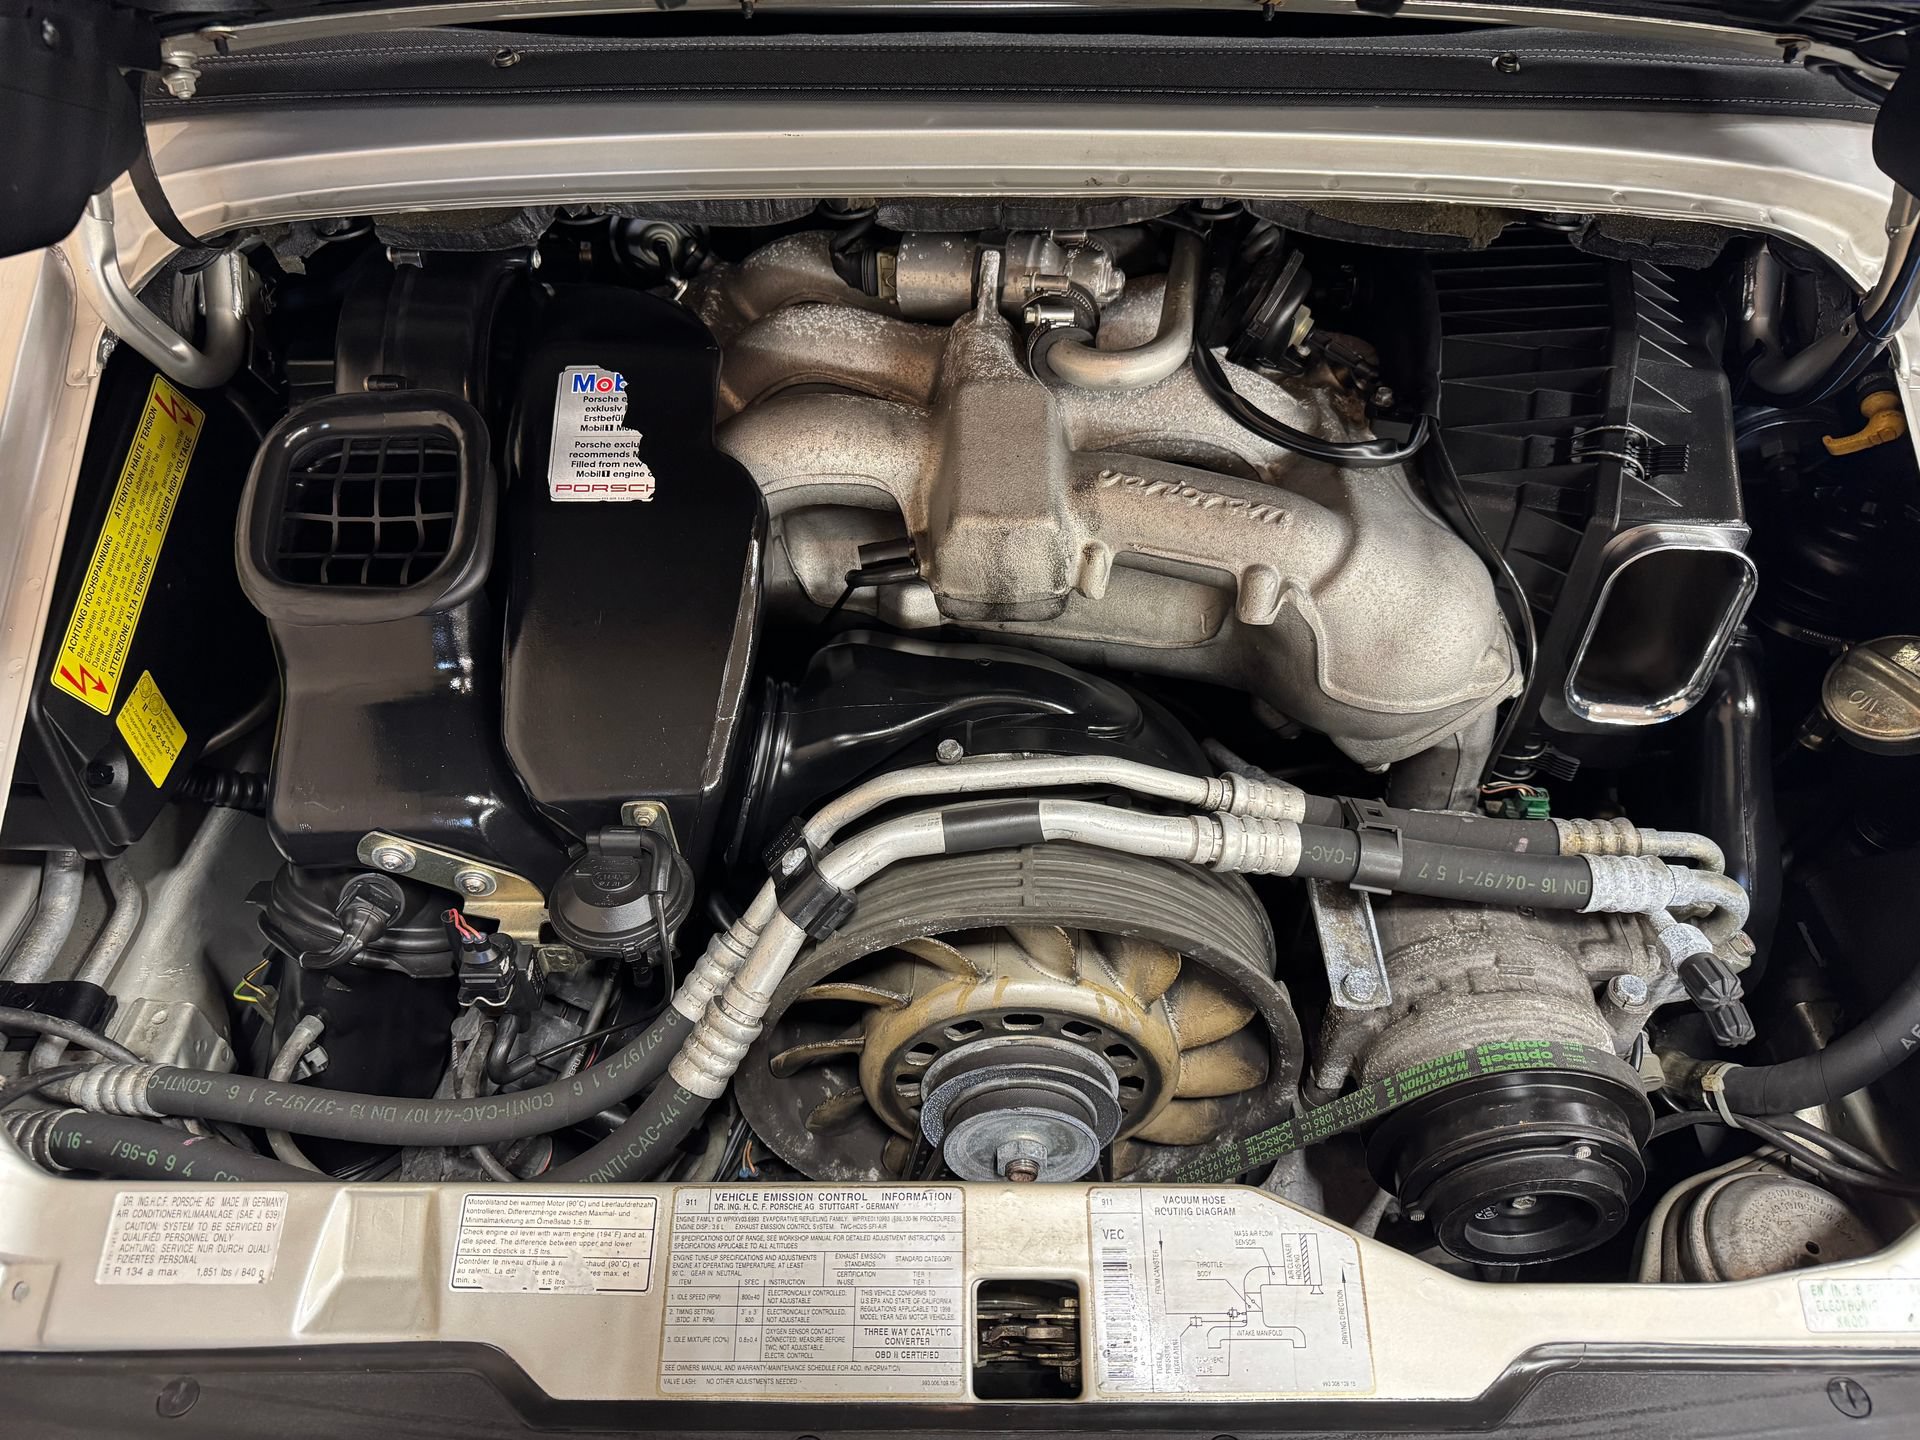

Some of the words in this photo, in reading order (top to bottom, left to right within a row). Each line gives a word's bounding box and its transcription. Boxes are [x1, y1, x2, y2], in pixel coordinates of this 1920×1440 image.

[116, 470, 135, 519] ATTENTION
[132, 441, 145, 471] HAUTE
[142, 406, 157, 441] TENSION
[613, 471, 645, 479] engine
[157, 496, 172, 532] DANGER
[169, 473, 179, 496] HIGH
[177, 435, 193, 473] VOLTAGE
[69, 608, 88, 653] ACHTUNG
[85, 535, 113, 607] HOCHSPANNUNG
[110, 623, 130, 678] ATTENZIONE
[127, 599, 138, 622] ALTA
[135, 555, 152, 596] TENSIONE
[1563, 879, 1588, 895] DN
[1480, 1051, 1553, 1067] optibelt
[1400, 1061, 1469, 1097] MARATHON
[1247, 1130, 1294, 1157] PORSCHE
[67, 1132, 82, 1149] 16
[164, 1155, 177, 1172] 9
[182, 1161, 196, 1178] 4
[172, 1196, 203, 1207] PORSCHE
[205, 1196, 215, 1207] AG
[221, 1196, 240, 1207] MADE
[242, 1196, 249, 1207] IN
[252, 1196, 284, 1207] GERMANY
[715, 1193, 758, 1201] VEHICLE
[763, 1193, 813, 1201] EMISSION
[818, 1193, 868, 1201] CONTROL
[881, 1193, 952, 1201] INFORMATION
[1102, 1198, 1113, 1206] 911
[1163, 1196, 1199, 1204] VACUUM
[1202, 1196, 1226, 1204] HOSE
[714, 1203, 726, 1211] DR.
[727, 1203, 741, 1211] ING.
[770, 1203, 803, 1211] PORSCHE
[805, 1203, 814, 1211] AG
[819, 1203, 859, 1211] STUTTGART
[866, 1203, 900, 1211] GERMANY
[1154, 1207, 1193, 1216] ROUTING
[1196, 1207, 1236, 1216] DIAGRAM
[116, 1209, 129, 1218] AIR
[163, 1222, 194, 1231] SYSTEM
[198, 1222, 208, 1231] TO
[212, 1222, 222, 1231] BE
[225, 1222, 263, 1231] SERVICED
[266, 1222, 277, 1231] BY
[122, 1233, 160, 1242] QUALIFIED
[165, 1233, 209, 1242] PERSONNEL
[213, 1233, 234, 1242] ONLY
[1102, 1229, 1125, 1240] VEC
[161, 1243, 194, 1253] SERVICE
[197, 1243, 214, 1253] NUR
[217, 1243, 244, 1253] DURCH
[116, 1254, 155, 1264] FIZIERTES
[158, 1254, 197, 1264] PERSONAL
[1285, 1243, 1294, 1269] CLEANER
[113, 1267, 122, 1276] R
[127, 1267, 143, 1276] 134
[221, 1268, 233, 1277] lbs
[241, 1268, 256, 1277] 840
[864, 1328, 888, 1336] THREE
[891, 1328, 908, 1336] WAY
[910, 1328, 952, 1336] CATALYTIC
[1338, 1321, 1349, 1345] DRIVING
[885, 1337, 930, 1345] CONVERTER
[875, 1351, 891, 1359] OBD
[901, 1351, 939, 1359] CERTIFIED
